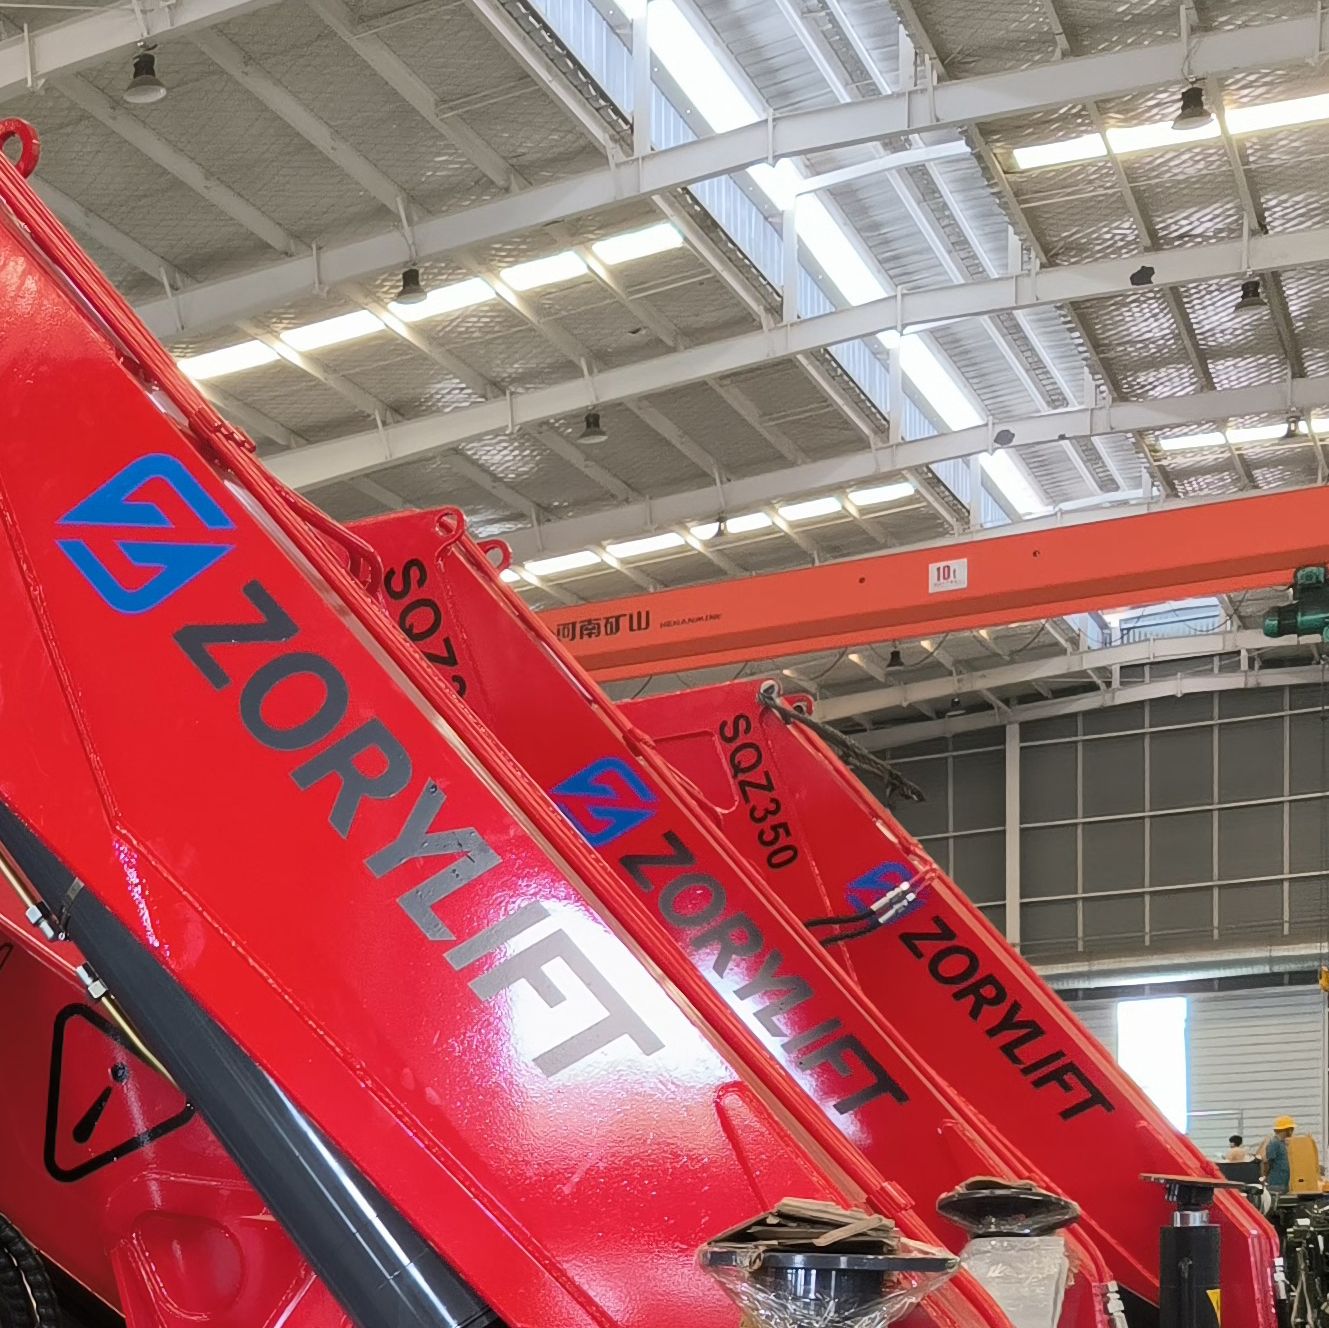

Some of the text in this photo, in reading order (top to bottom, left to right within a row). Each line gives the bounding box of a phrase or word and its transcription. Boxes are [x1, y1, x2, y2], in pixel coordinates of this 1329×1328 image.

[556, 610, 651, 641] 河南矿山
[173, 579, 665, 1077] ZORYLIFT
[719, 713, 798, 869] SQZ350
[620, 830, 909, 1115] ZORYLIFT
[899, 915, 1115, 1122] ZORYLIFT
